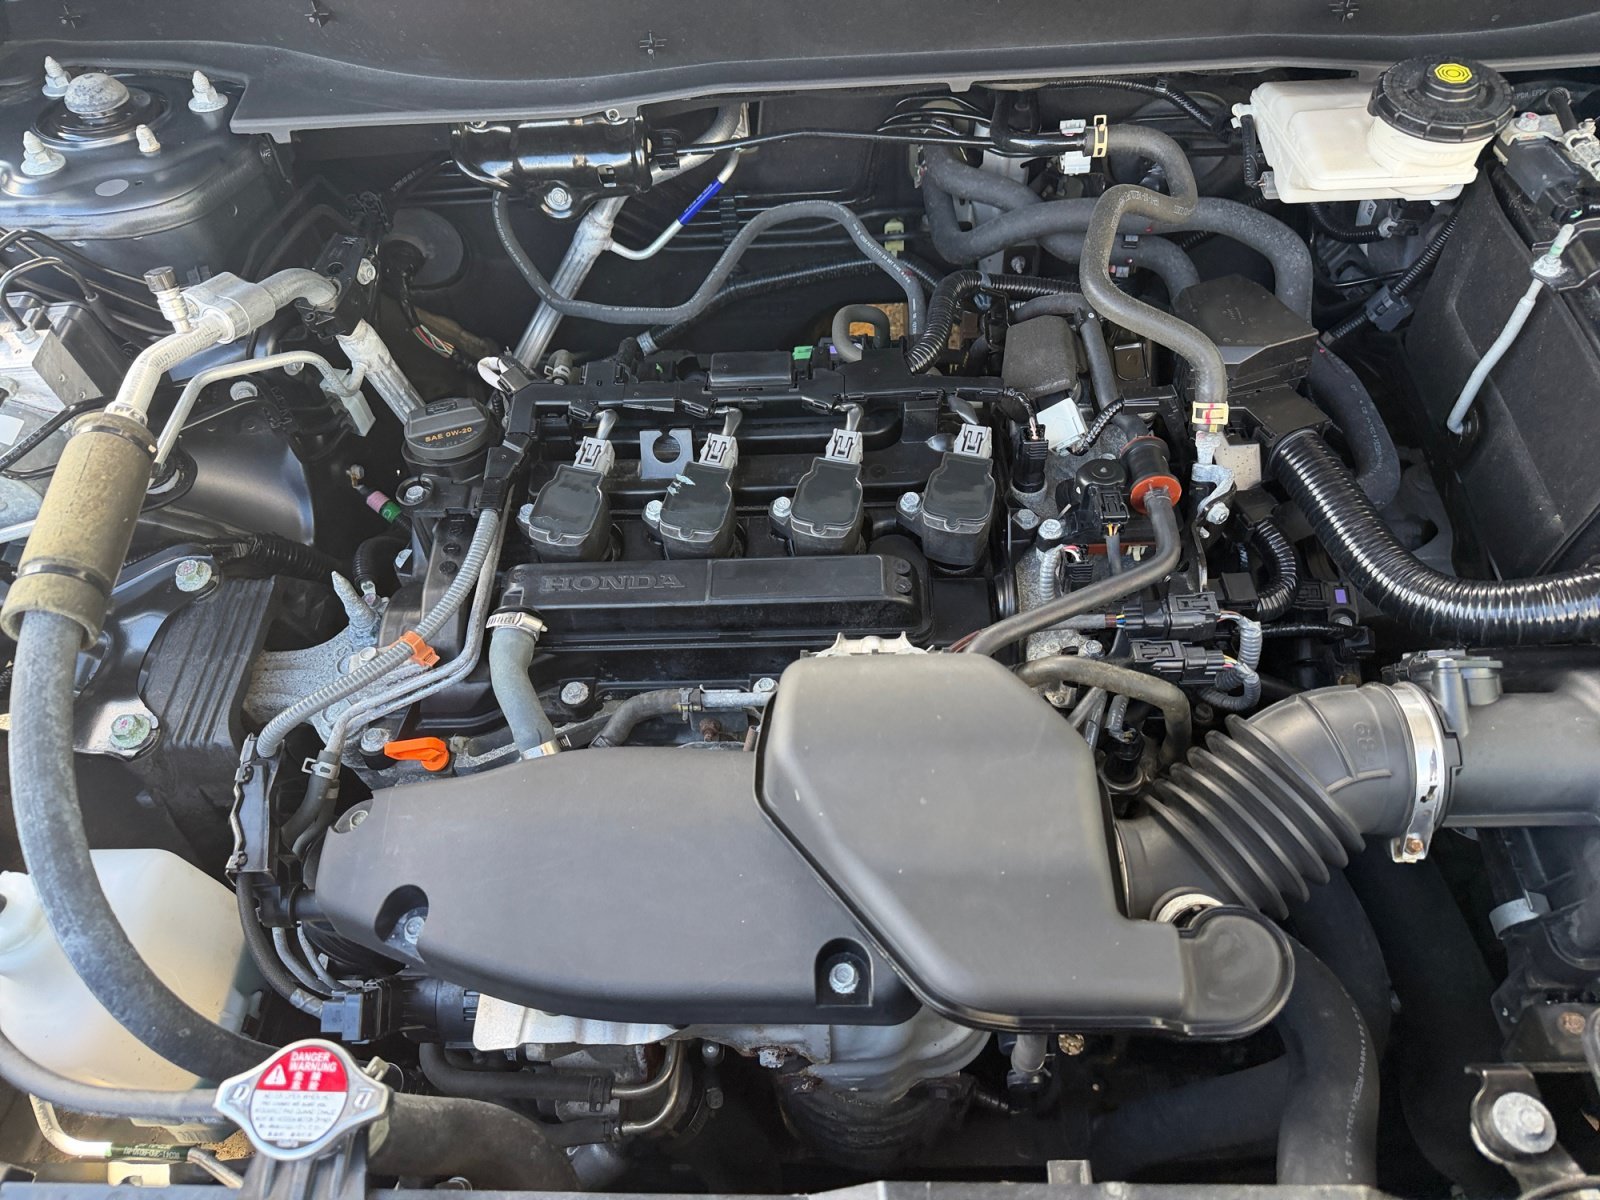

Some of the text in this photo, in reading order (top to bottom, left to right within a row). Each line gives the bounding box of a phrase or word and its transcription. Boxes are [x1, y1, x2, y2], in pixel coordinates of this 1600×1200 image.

[424, 433, 444, 443] SAE
[445, 426, 473, 438] 0W-20
[540, 573, 685, 593] HONDA
[290, 1051, 331, 1062] DANGER
[288, 1061, 338, 1072] WARNUNG
